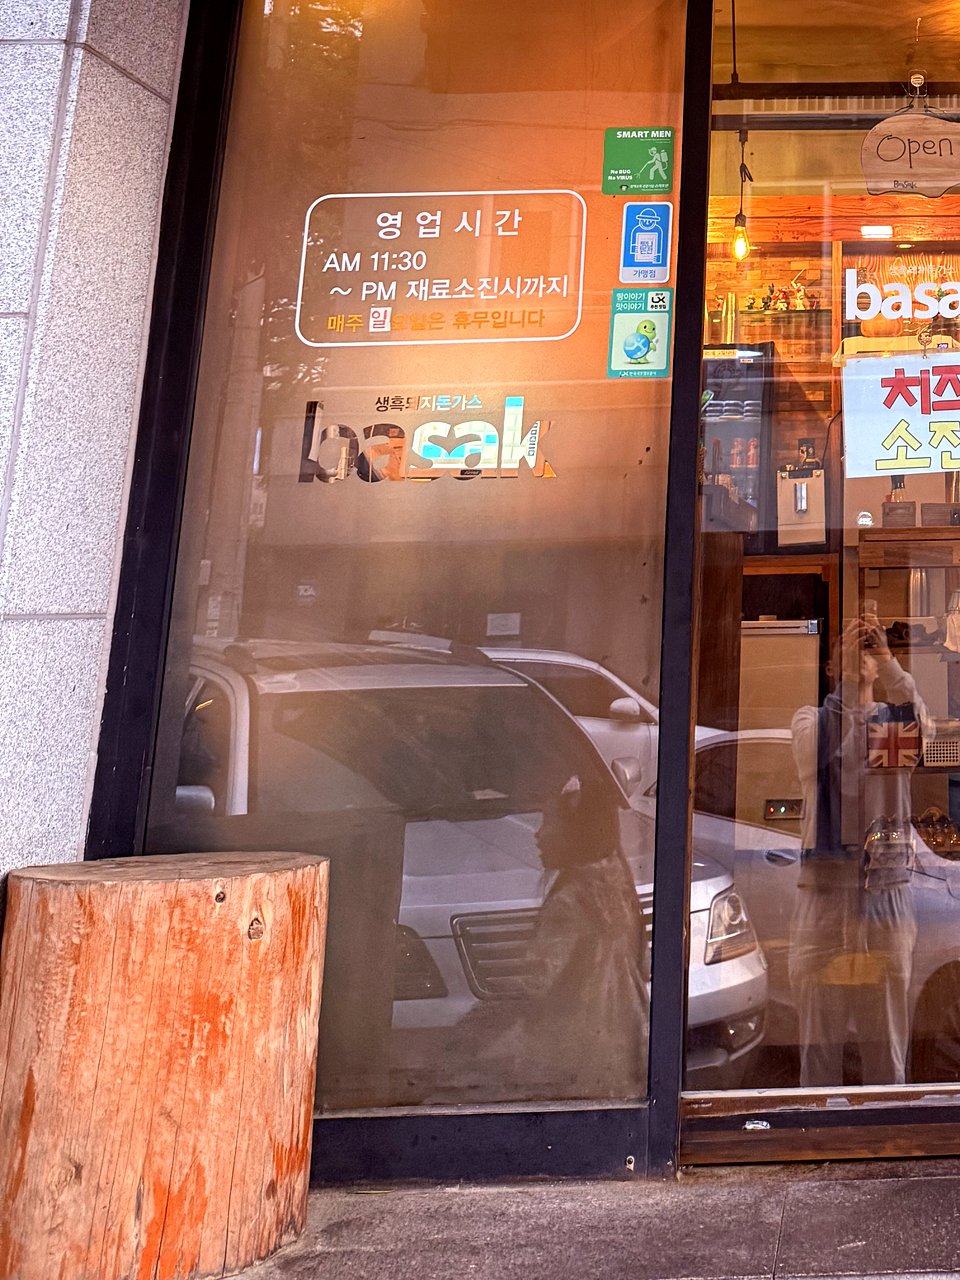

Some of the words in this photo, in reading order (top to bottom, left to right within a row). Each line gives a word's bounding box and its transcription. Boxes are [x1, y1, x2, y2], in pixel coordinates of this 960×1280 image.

[876, 134, 954, 169] Open
[322, 252, 361, 273] AM
[370, 250, 427, 272] 11:30
[632, 269, 657, 279] 가맹점
[361, 280, 397, 301] PM
[405, 275, 568, 301] 재료소진시까지
[615, 302, 645, 311] 맛이야기
[327, 313, 365, 333] 매주
[452, 308, 546, 330] 휴무입니다
[298, 396, 558, 483] basak
